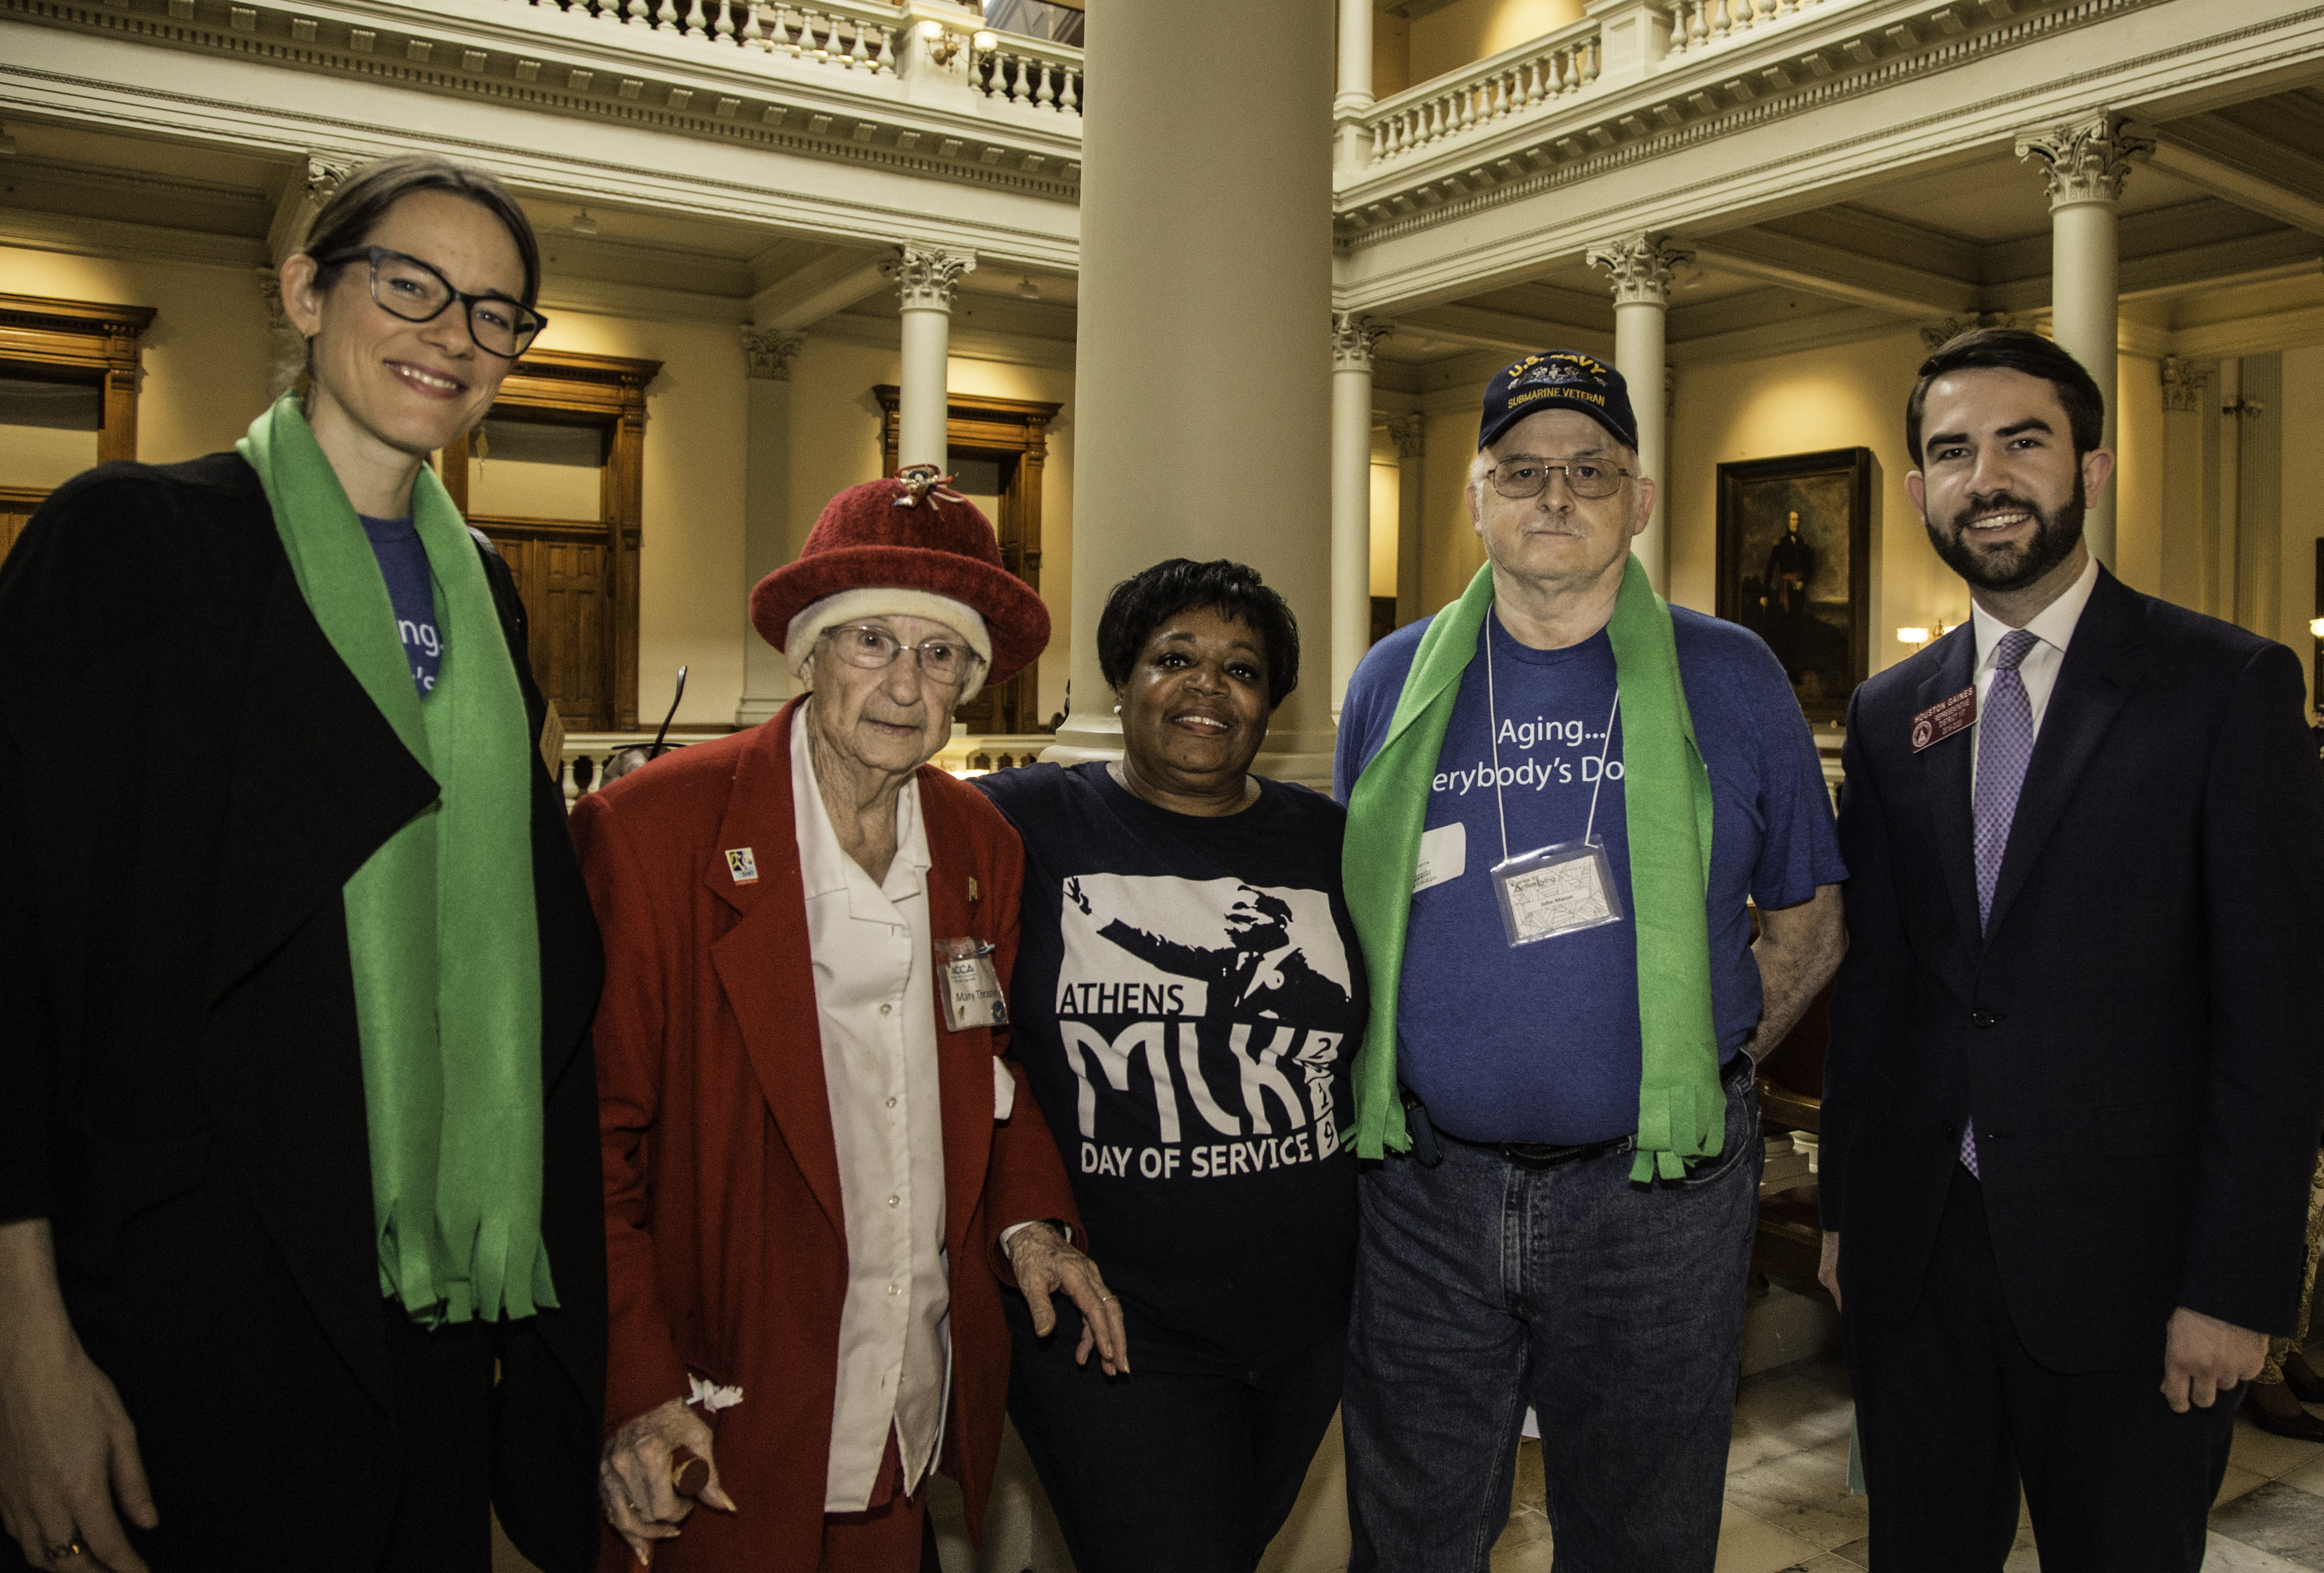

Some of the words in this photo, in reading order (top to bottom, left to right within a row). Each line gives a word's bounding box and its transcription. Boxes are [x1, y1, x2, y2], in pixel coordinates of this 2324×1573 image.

[1508, 355, 1545, 377] U.S.
[1550, 354, 1606, 373] VY
[1508, 387, 1561, 409] SUBMARINE
[1563, 387, 1605, 406] VETERAN
[1914, 701, 1946, 724] HOUSTON
[1947, 687, 1973, 706] GAINES
[1497, 715, 1606, 749] Aging...
[1061, 982, 1185, 1015] ATHENS
[1060, 1020, 1306, 1143] MLK
[1081, 1142, 1133, 1178] DAY
[1140, 1148, 1181, 1179] OF
[1191, 1132, 1313, 1178] SERVICE
